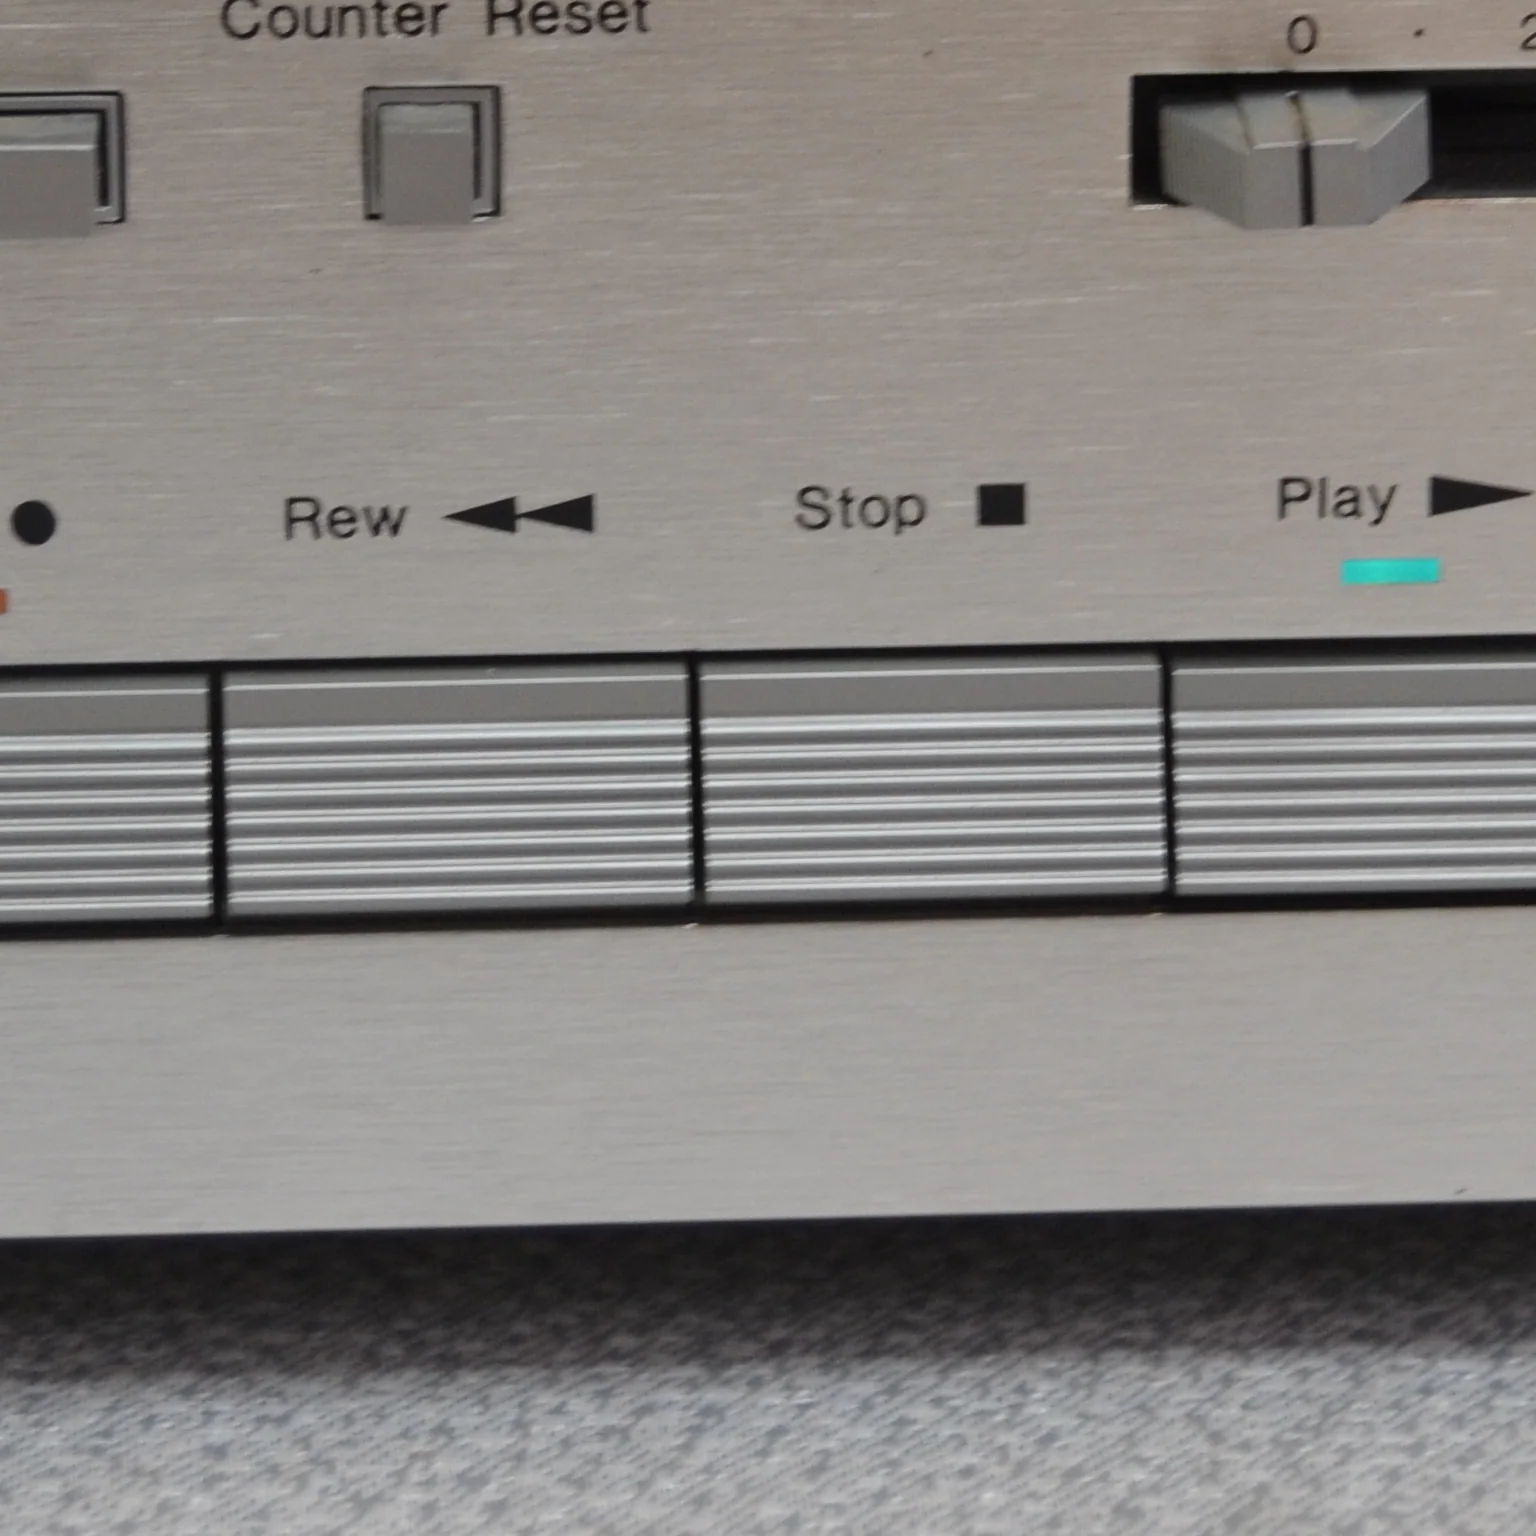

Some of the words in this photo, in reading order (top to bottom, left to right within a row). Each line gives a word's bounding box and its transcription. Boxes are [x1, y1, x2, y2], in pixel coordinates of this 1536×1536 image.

[1287, 15, 1318, 55] 0
[285, 496, 407, 540] Rew
[796, 485, 926, 535] Stop
[1278, 476, 1397, 526] Play
